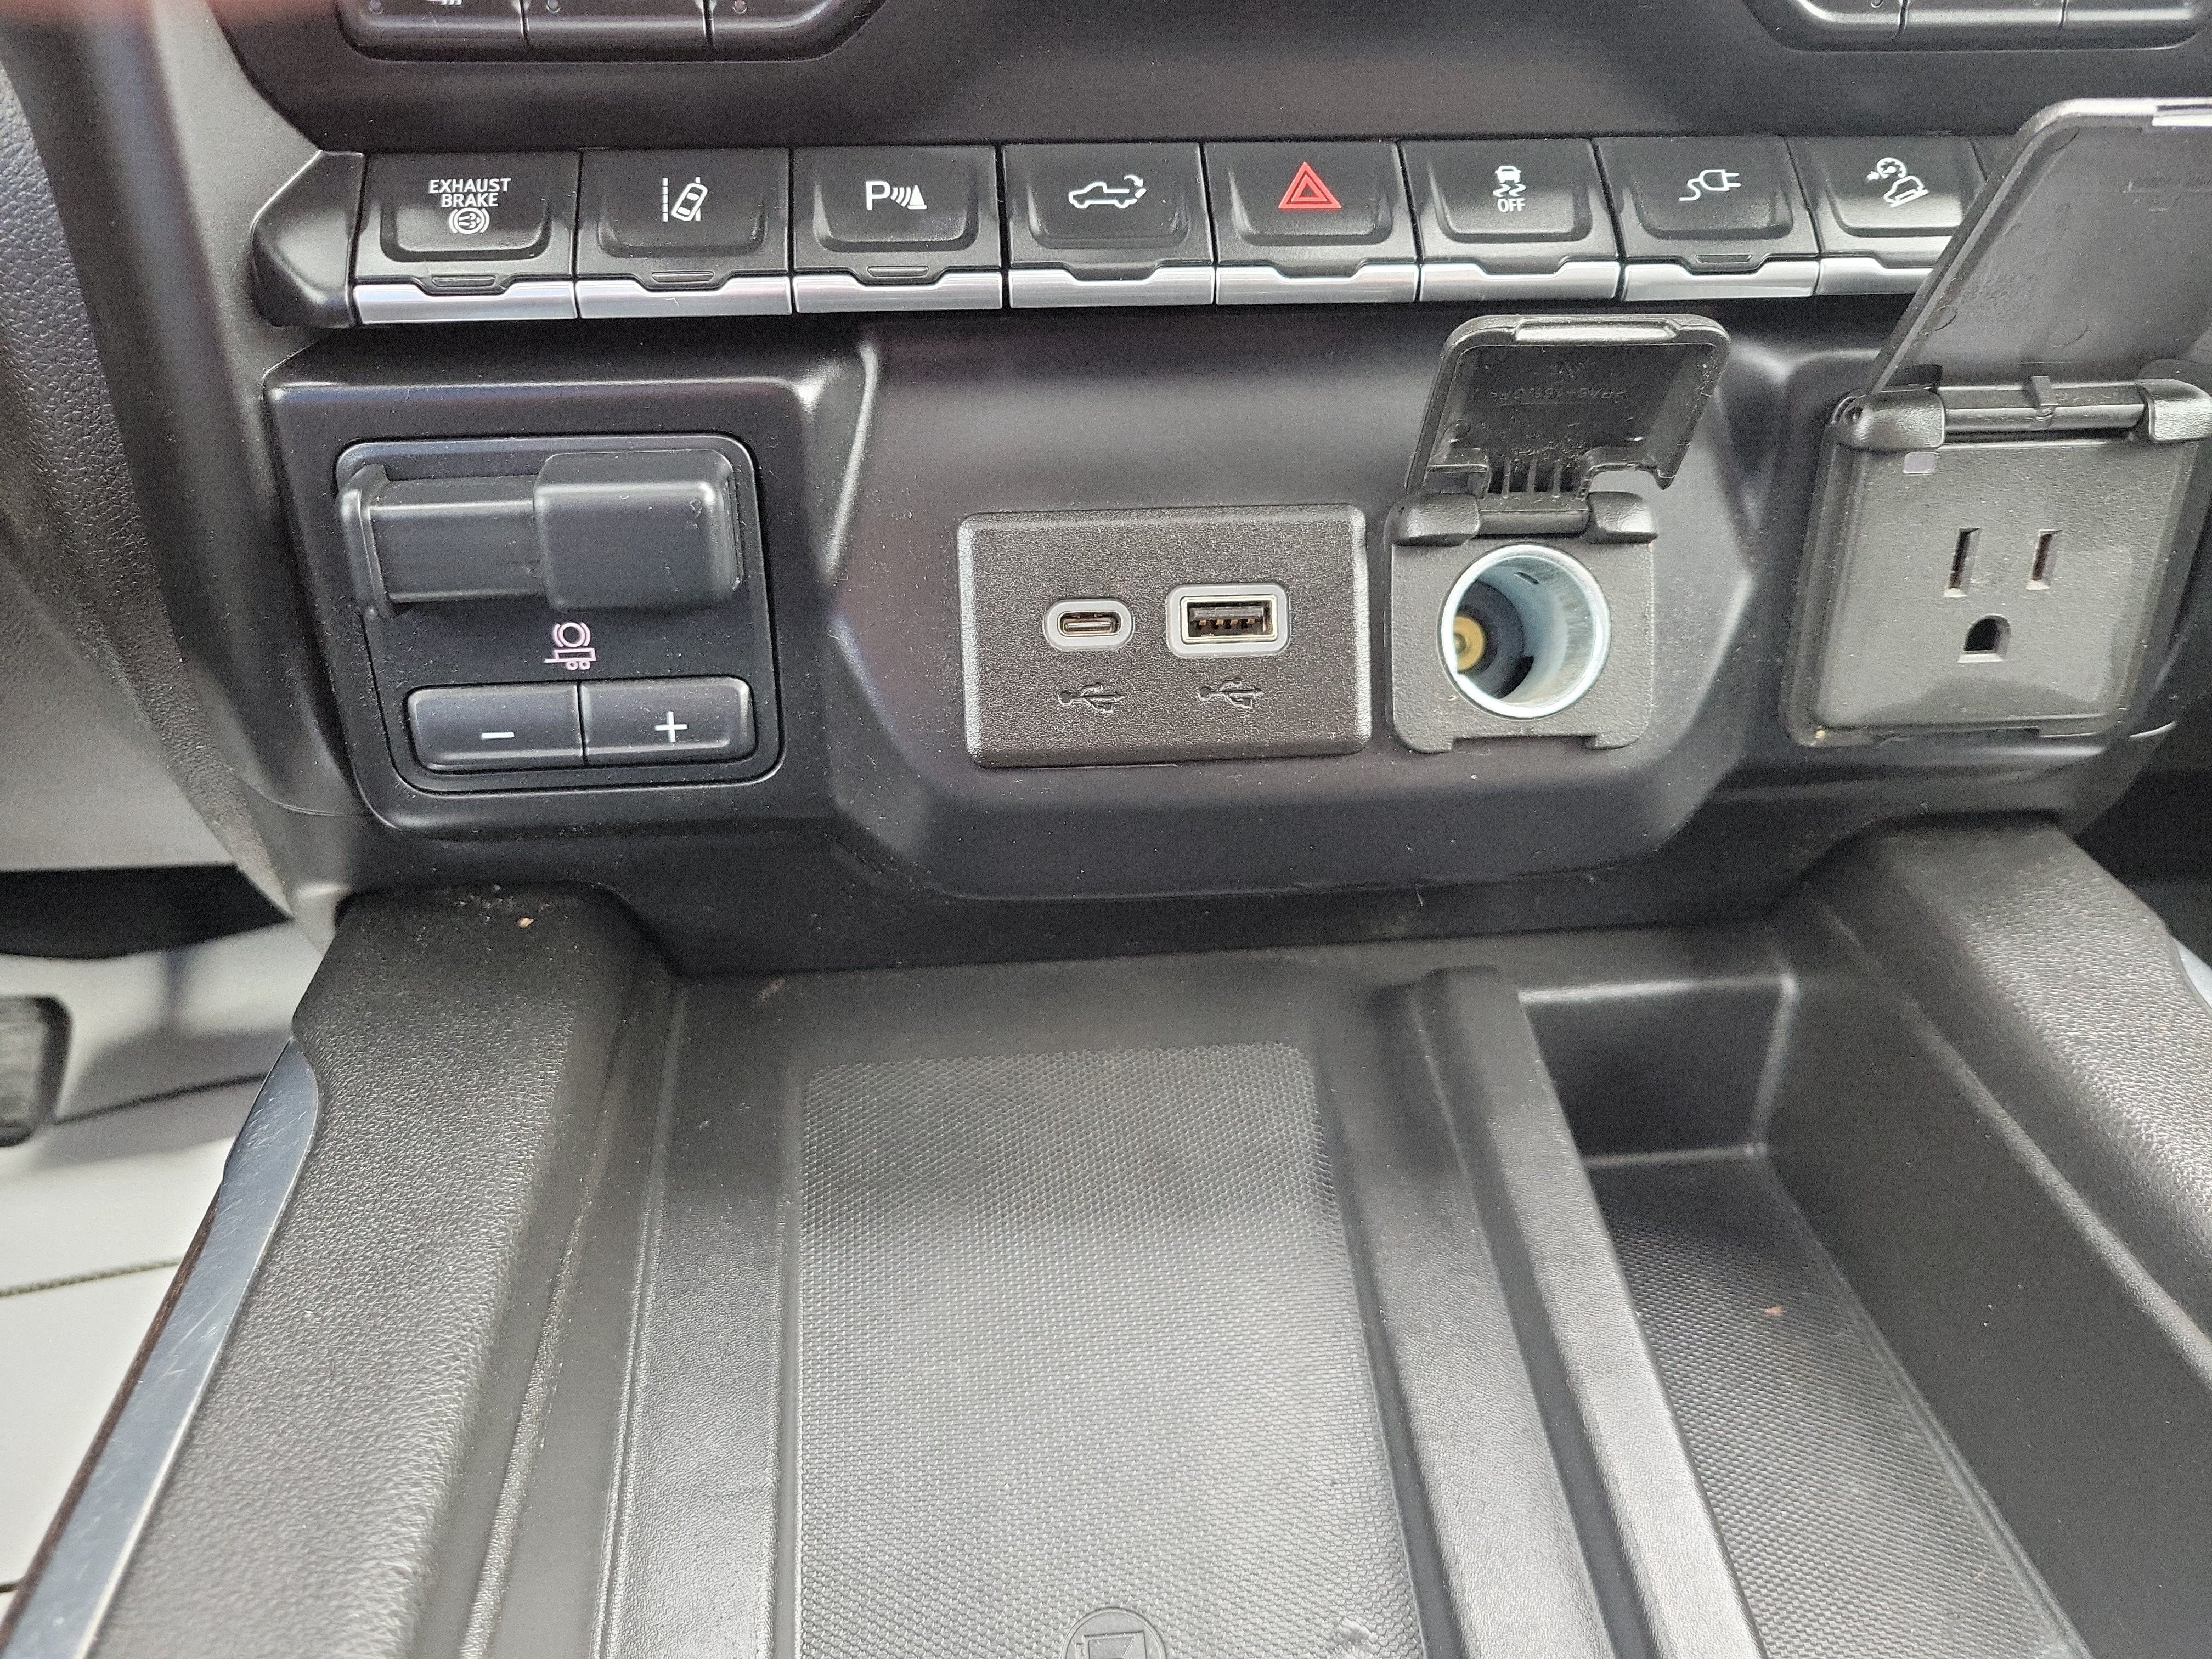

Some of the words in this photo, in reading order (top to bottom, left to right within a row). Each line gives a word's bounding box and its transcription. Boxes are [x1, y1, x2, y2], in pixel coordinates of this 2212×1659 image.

[428, 178, 512, 193] EXHAUST
[441, 193, 499, 207] BRAKE
[865, 180, 891, 210] P
[1497, 198, 1526, 212] OFF
